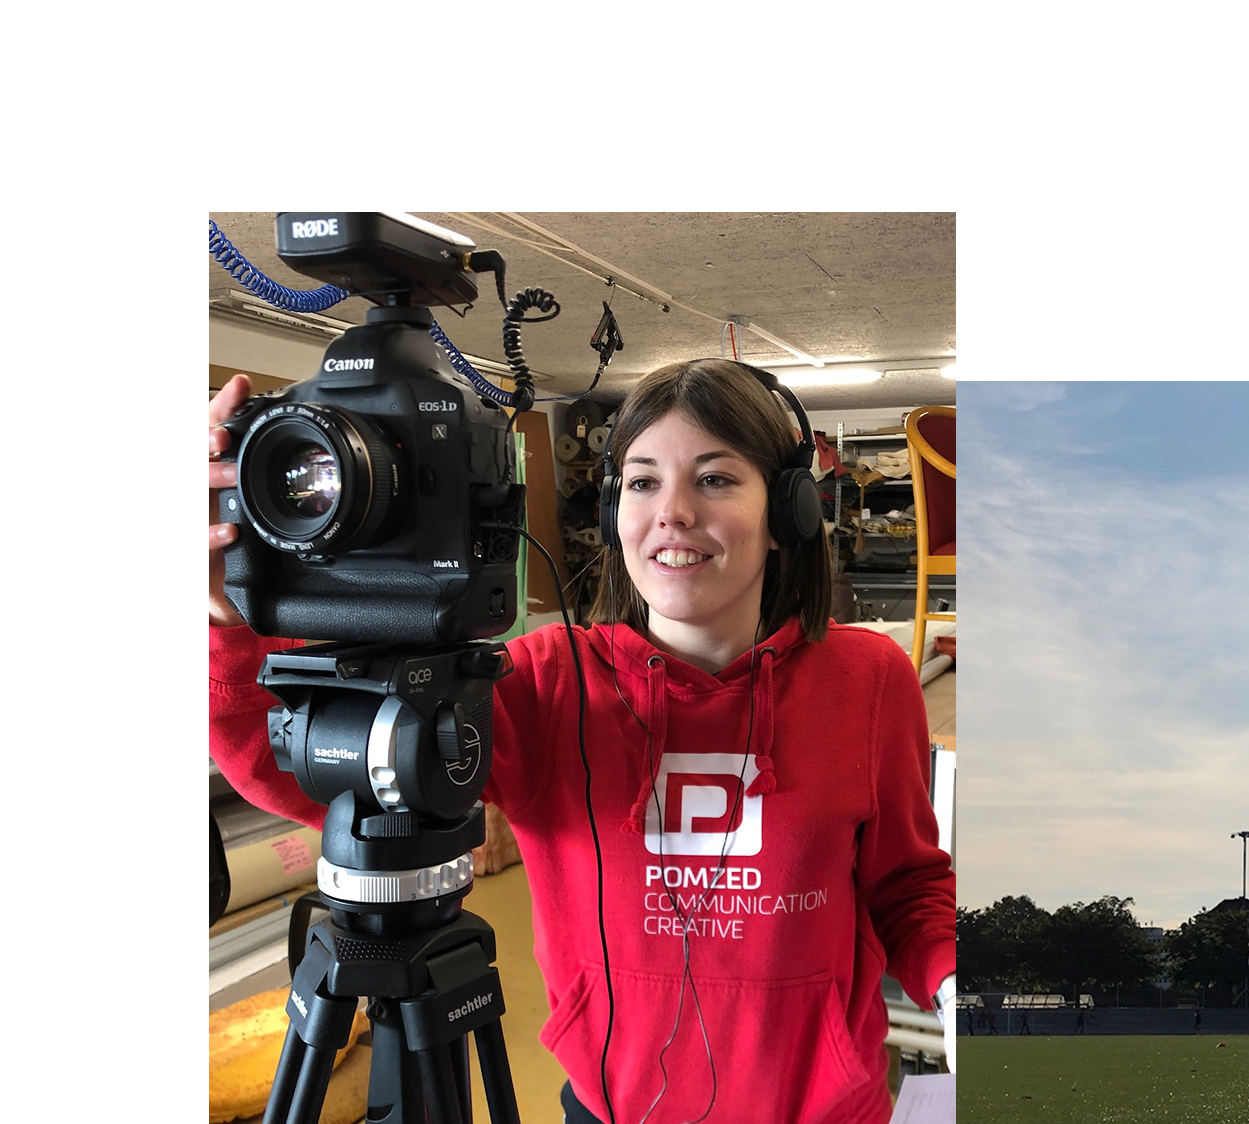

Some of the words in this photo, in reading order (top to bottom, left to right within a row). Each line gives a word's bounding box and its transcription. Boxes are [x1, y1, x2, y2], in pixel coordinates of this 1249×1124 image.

[292, 218, 339, 239] RØDE
[324, 358, 375, 373] Canon
[323, 521, 341, 541] CANON
[433, 560, 453, 568] Mark
[408, 668, 433, 685] ace
[314, 747, 360, 760] sachtler
[314, 757, 340, 765] GERMANY
[645, 865, 762, 890] POMZED
[644, 888, 828, 916] COMMUNICATION
[447, 992, 493, 1022] sachtler
